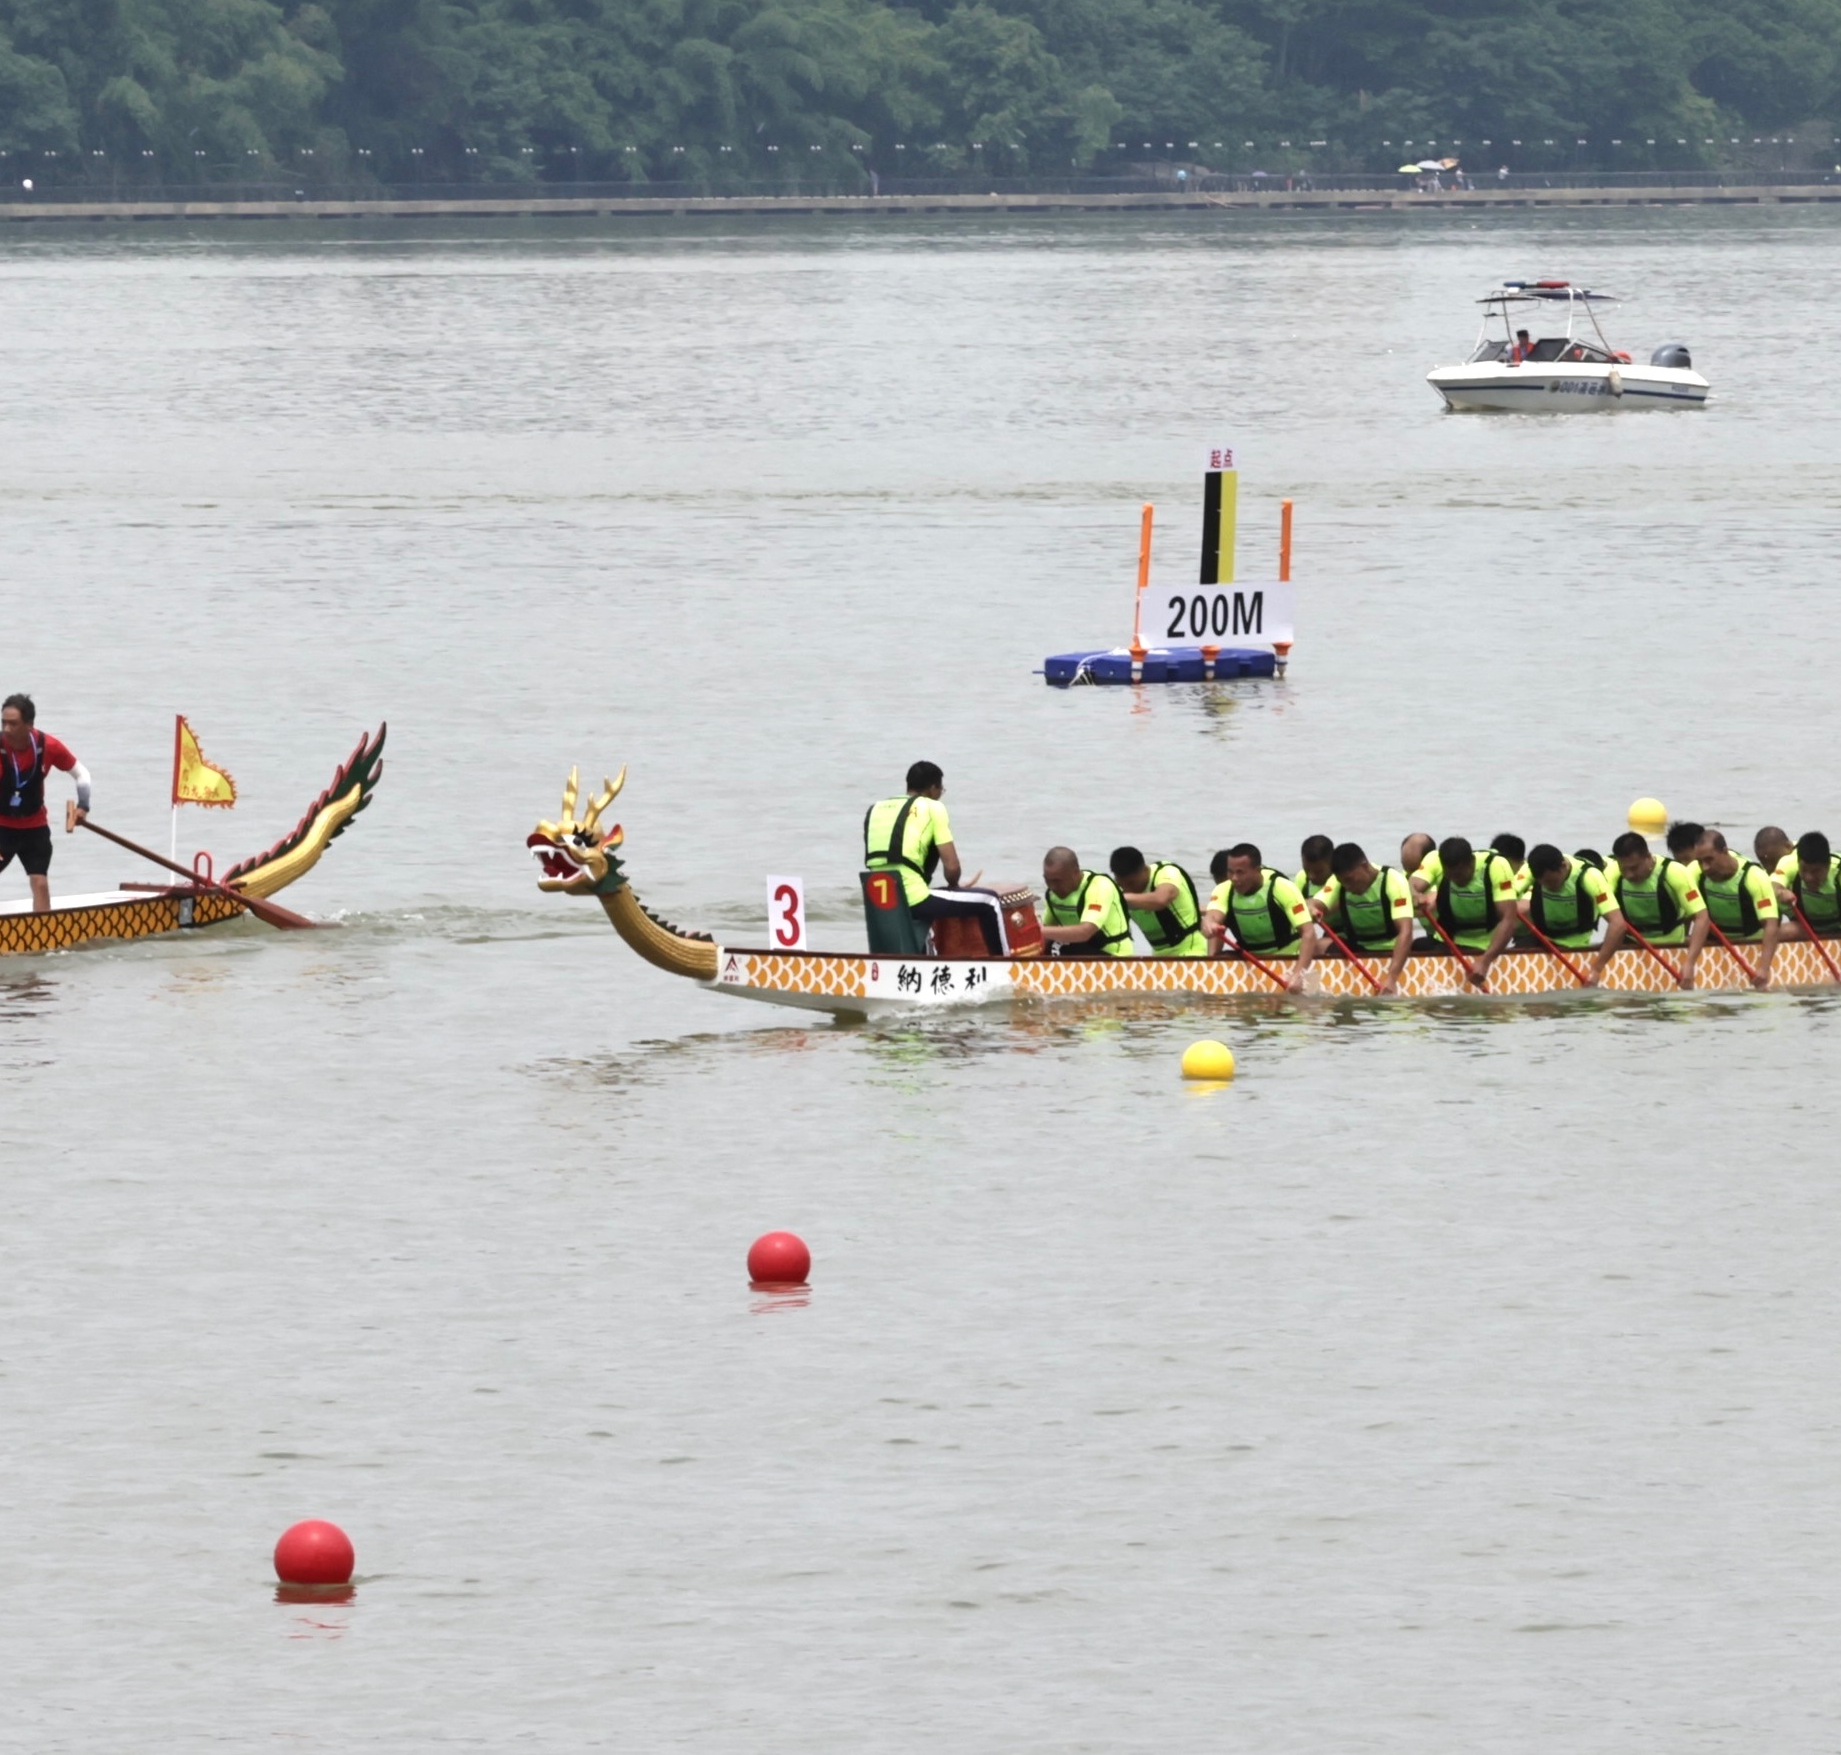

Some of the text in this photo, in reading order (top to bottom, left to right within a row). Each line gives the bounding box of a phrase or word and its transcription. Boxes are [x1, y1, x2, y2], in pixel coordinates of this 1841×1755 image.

[1167, 591, 1263, 638] 200M
[873, 879, 889, 903] 7
[774, 884, 800, 947] 3
[897, 964, 987, 995] 納德利
